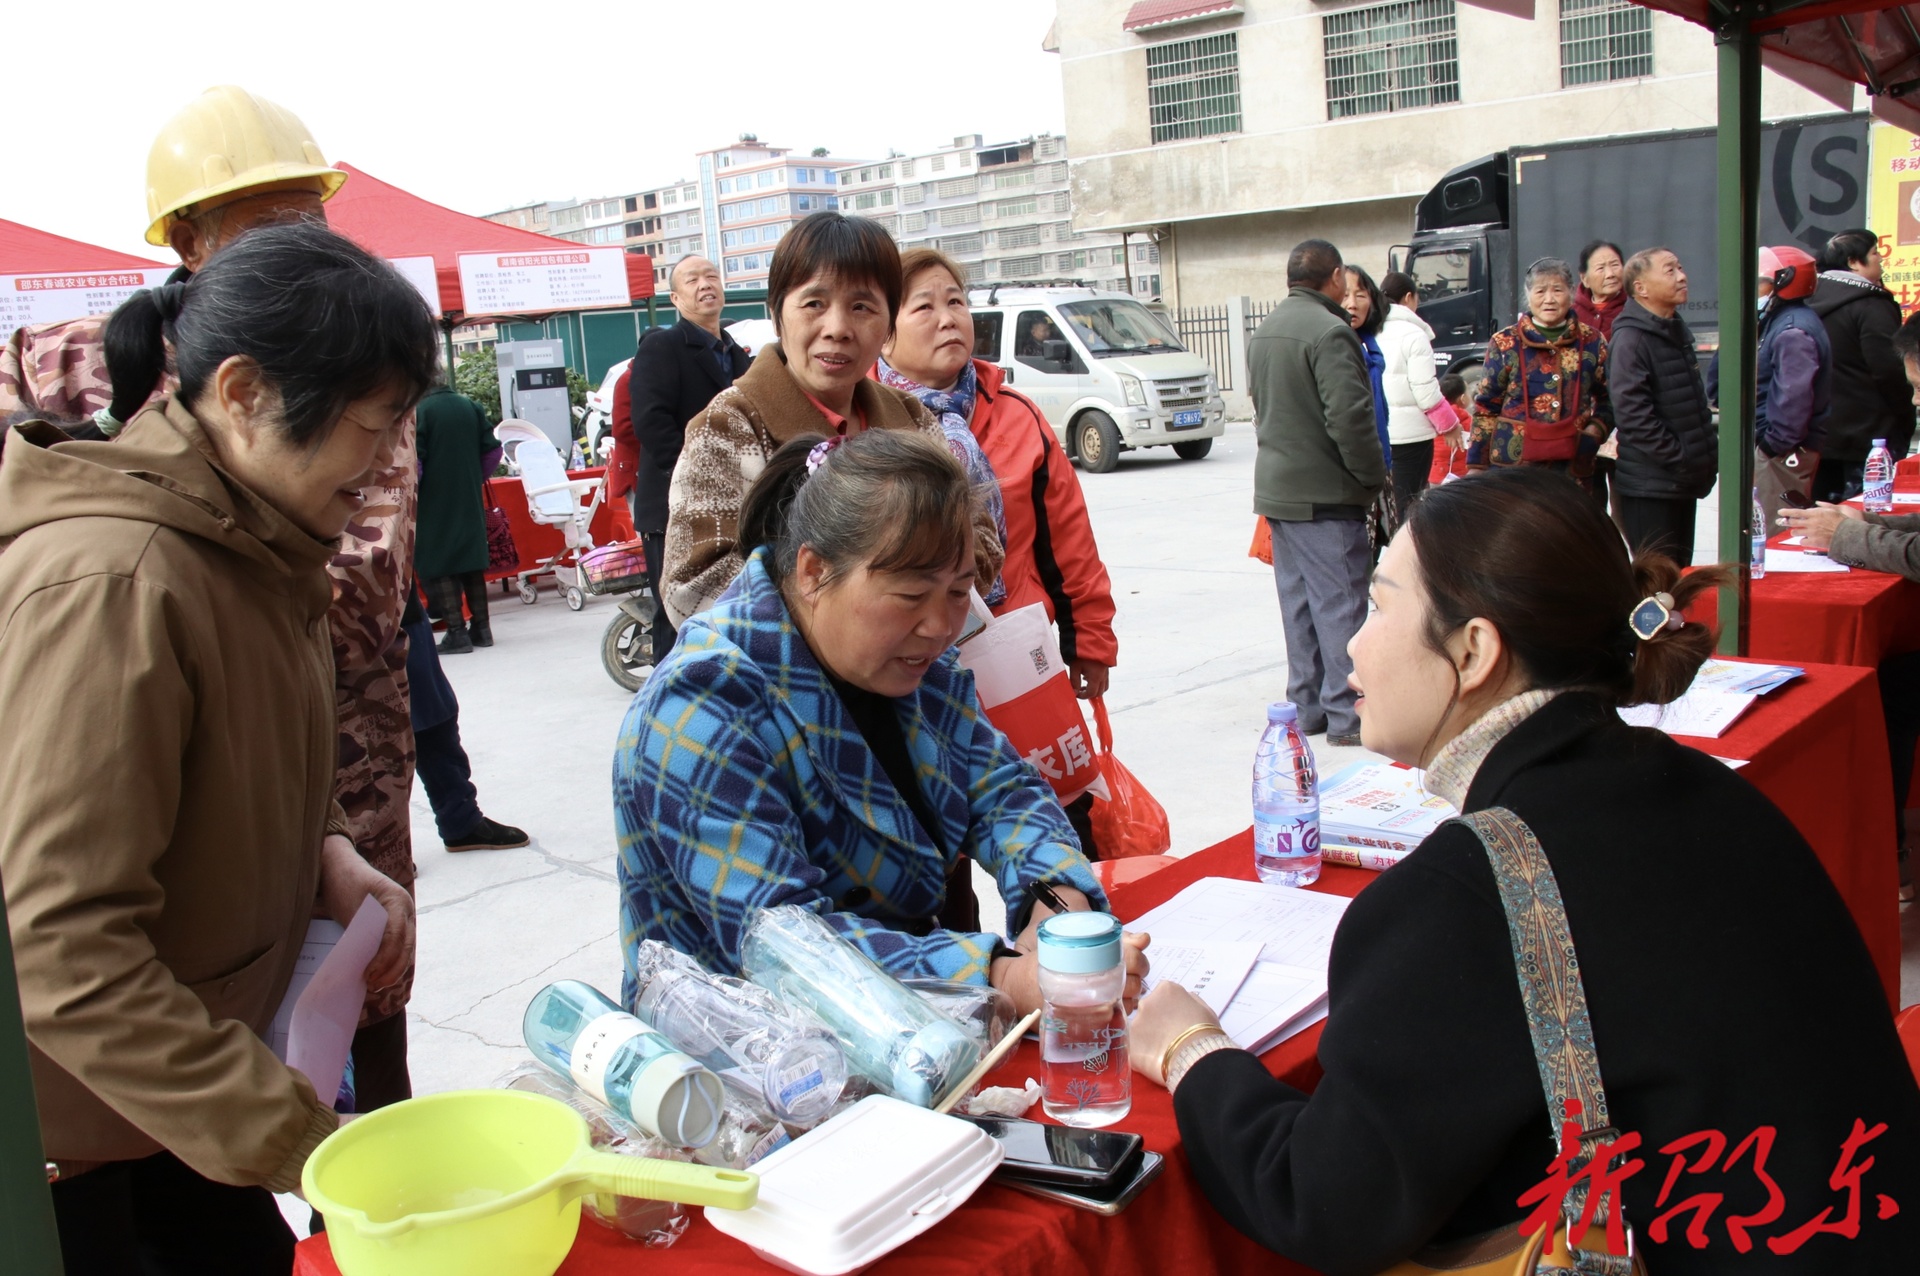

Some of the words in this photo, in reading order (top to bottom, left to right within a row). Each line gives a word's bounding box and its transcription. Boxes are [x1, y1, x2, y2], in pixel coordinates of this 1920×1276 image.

[21, 274, 139, 290] 邵东春诚农业专业合作社
[1347, 835, 1407, 852] 就业机会
